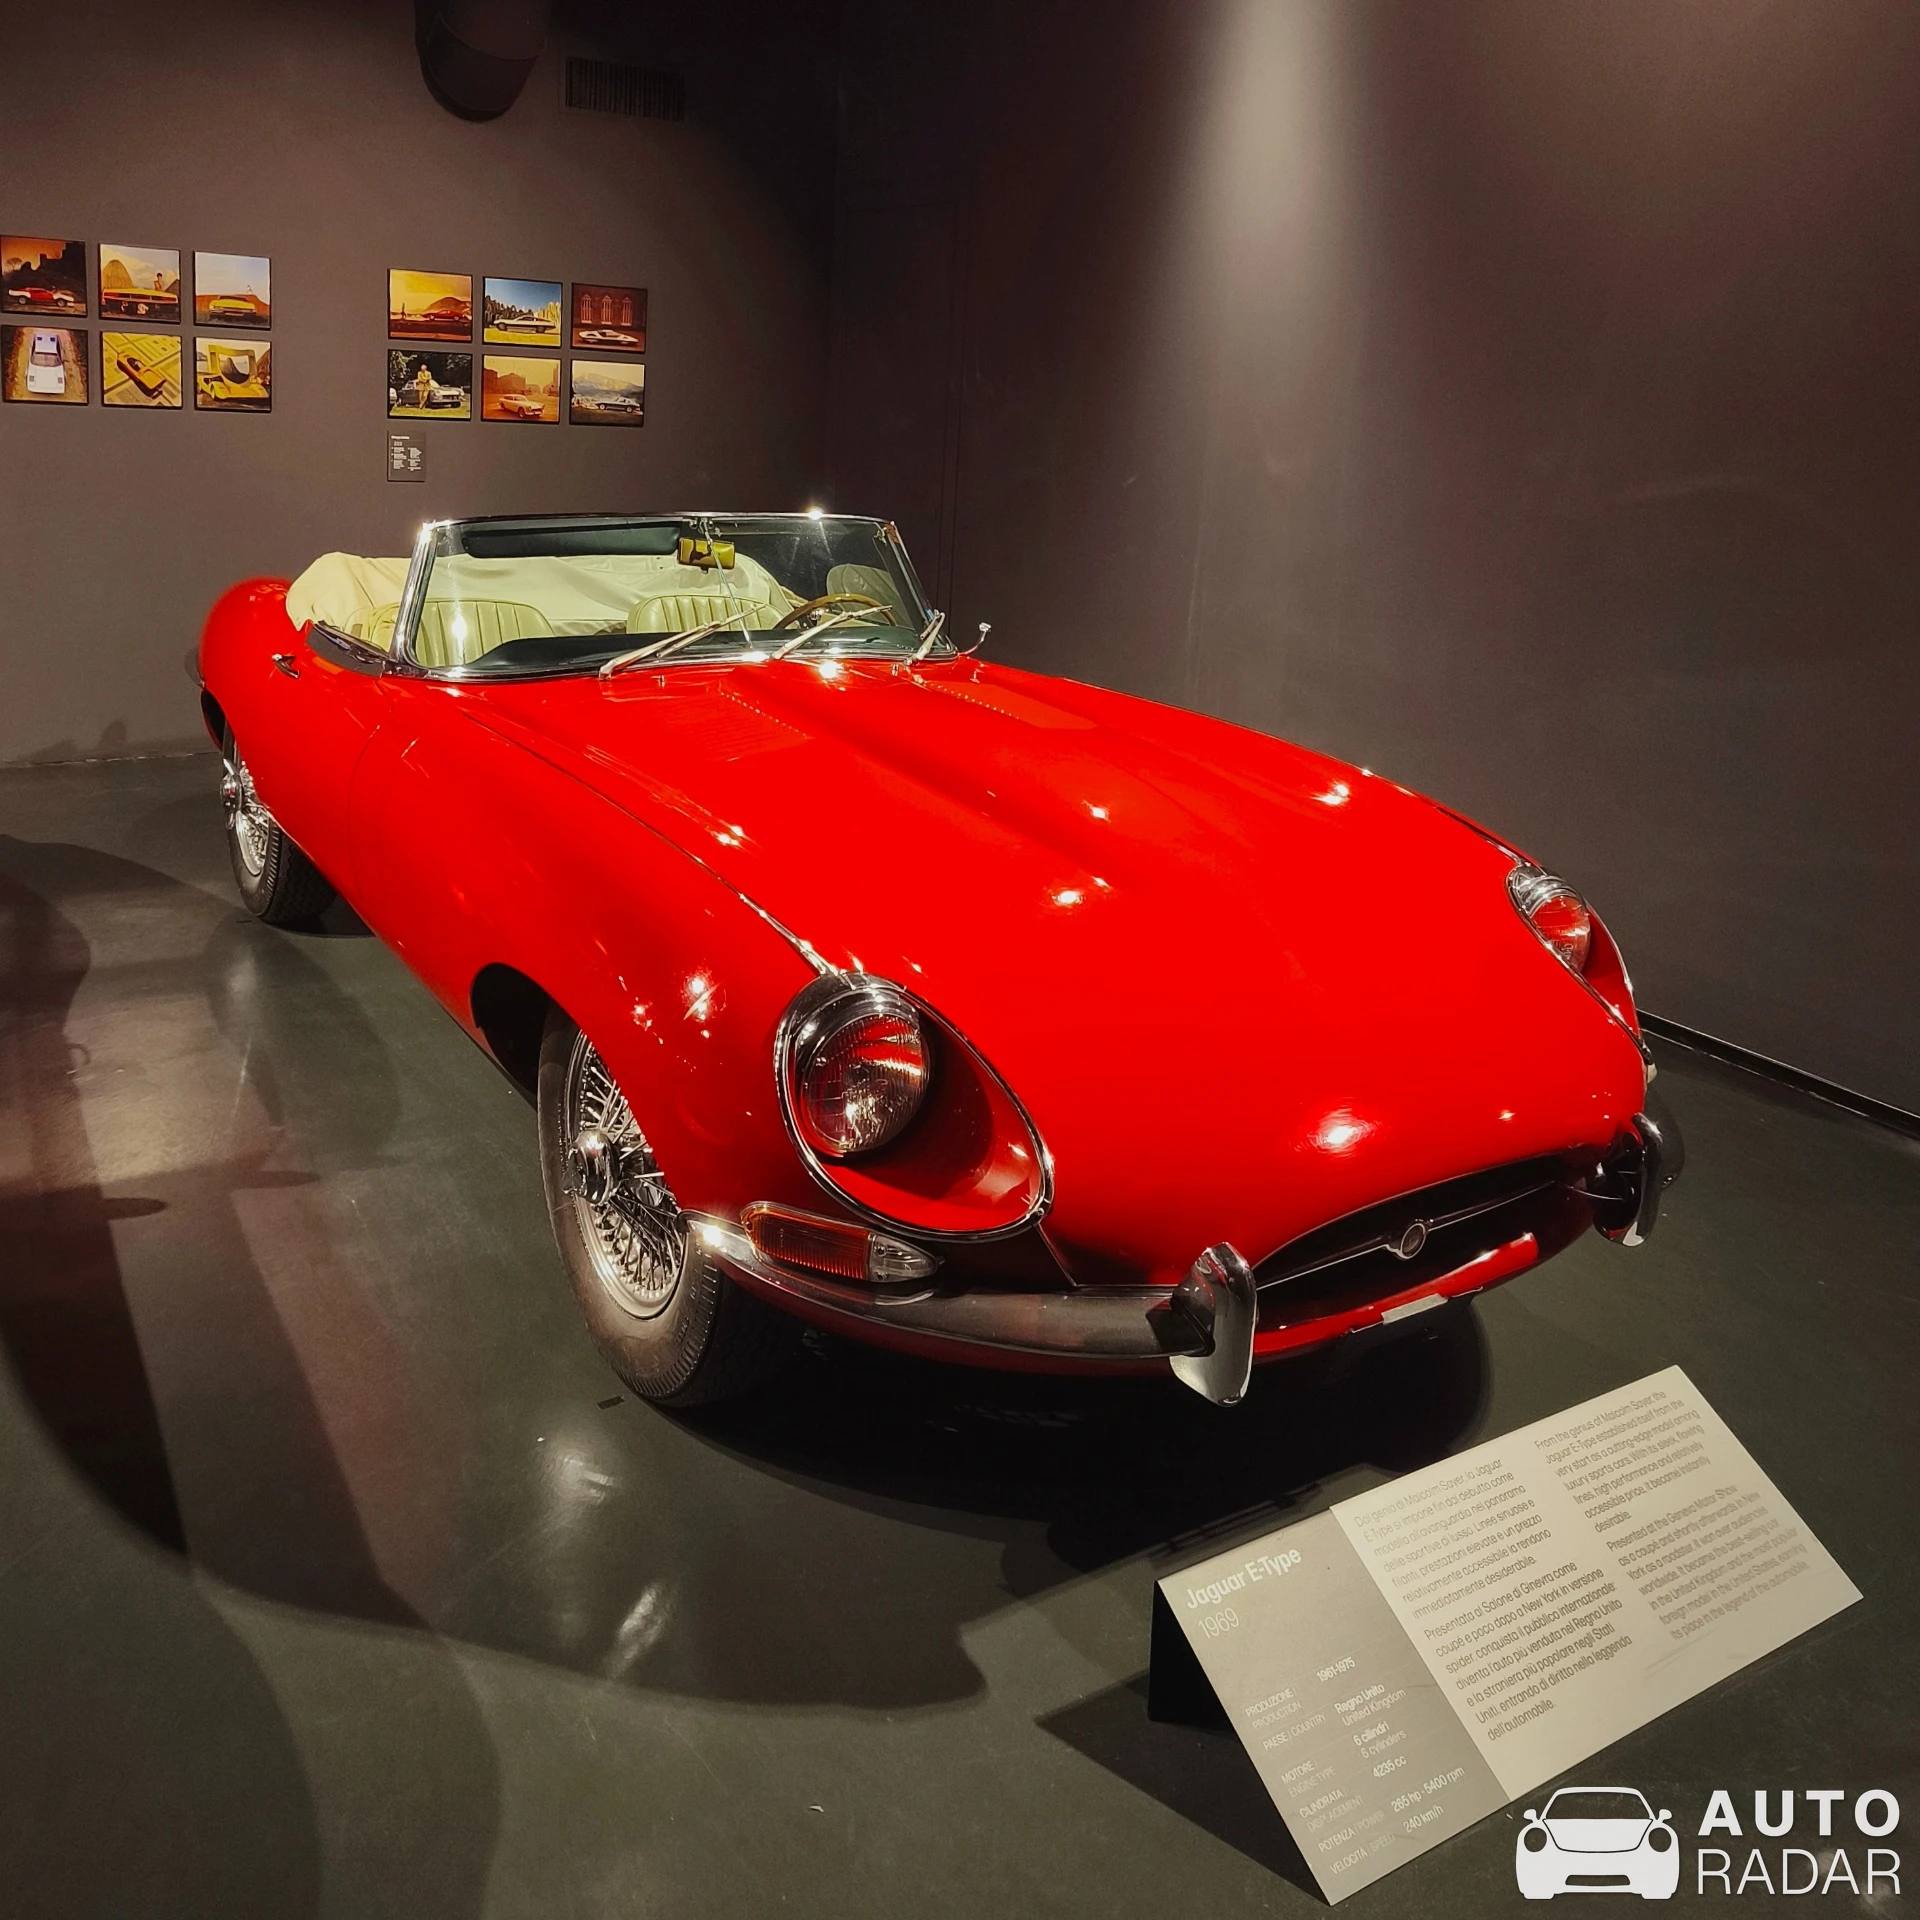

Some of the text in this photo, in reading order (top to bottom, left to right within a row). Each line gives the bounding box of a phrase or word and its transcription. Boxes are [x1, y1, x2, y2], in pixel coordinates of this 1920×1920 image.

[1535, 1437, 1557, 1449] From
[1555, 1432, 1570, 1441] the
[1569, 1421, 1594, 1438] genius
[1594, 1416, 1602, 1425] of
[1601, 1405, 1633, 1422] Malcolm
[1651, 1391, 1666, 1400] the
[1546, 1448, 1572, 1463] Jaguar
[1570, 1438, 1597, 1452] E-Type
[1653, 1405, 1672, 1416] from
[1669, 1400, 1684, 1409] the
[1555, 1465, 1574, 1477] very
[1573, 1456, 1592, 1469] start
[1591, 1453, 1602, 1461] as
[1607, 1430, 1653, 1454] cutting-edge
[1652, 1419, 1675, 1434] model
[1674, 1410, 1700, 1425] among
[1355, 1513, 1372, 1526] Dal
[1372, 1505, 1396, 1522] genio
[1397, 1499, 1406, 1509] di
[1404, 1486, 1441, 1505] Malcolm
[1464, 1471, 1475, 1479] la
[1475, 1459, 1502, 1475] Jaguar
[1564, 1476, 1590, 1491] luxury
[1589, 1465, 1614, 1481] sports
[1593, 1483, 1612, 1495] high
[1611, 1462, 1658, 1490] performance
[1657, 1454, 1673, 1466] and
[1364, 1473, 1514, 1542] E-Type si impone fin dal debutto come
[1585, 1495, 1626, 1518] accessible
[1644, 1481, 1653, 1490] it
[1375, 1486, 1526, 1557] modello all'avanguardia nel panorama
[1385, 1558, 1405, 1572] delle
[1406, 1542, 1441, 1563] sportive
[1442, 1536, 1451, 1546] di
[1473, 1516, 1497, 1531] Linee
[1497, 1502, 1529, 1521] sinuose
[1403, 1530, 1551, 1603] relativamente accessibile la rendono
[1419, 1547, 1468, 1578] prestazioni
[1467, 1535, 1497, 1553] elevate
[1503, 1527, 1516, 1536] un
[1514, 1515, 1542, 1534] prezzo
[1187, 1550, 1302, 1608] Jaguar E-Type
[1411, 1580, 1485, 1619] immediatamente
[1425, 1562, 1576, 1640] Presentata al Salone di Ginevra come
[1436, 1635, 1464, 1656] coupé
[1471, 1623, 1495, 1642] poco
[1495, 1612, 1517, 1628] dopo
[1522, 1599, 1544, 1613] New
[1541, 1589, 1562, 1603] York
[1559, 1586, 1570, 1595] in
[1568, 1569, 1603, 1590] versione
[1199, 1609, 1239, 1639] 1969
[1446, 1582, 1617, 1674] spider, conquista il pubblico internazionale:
[1457, 1600, 1622, 1689] diventa l'auto più venduta nel Regno Unito
[1318, 1659, 1355, 1681] 1961-1975
[1467, 1622, 1615, 1706] e la straniera più popolare negli Stati
[1476, 1636, 1632, 1723] Uniti, entrando di diritto nella leggenda
[1246, 1689, 1293, 1717] PRODUZIONE
[1335, 1685, 1384, 1713] Regno Unito
[1343, 1691, 1406, 1726] United Kingdom
[1263, 1713, 1325, 1749] PAESE COUNTRY
[1354, 1722, 1390, 1745] 6 cilindri
[1488, 1700, 1555, 1740] dell'automobile.
[1362, 1732, 1406, 1758] 6 cylinders
[1281, 1761, 1314, 1783] MOTORE
[1373, 1758, 1406, 1779] 4235 cc
[1300, 1789, 1343, 1817] CILINDRATA
[1392, 1797, 1409, 1811] 265
[1409, 1792, 1421, 1803] hp
[1425, 1776, 1447, 1793] 5400
[1447, 1768, 1464, 1783] rpm
[1318, 1828, 1355, 1852] POTENZA
[1405, 1807, 1444, 1832] 240 km/h
